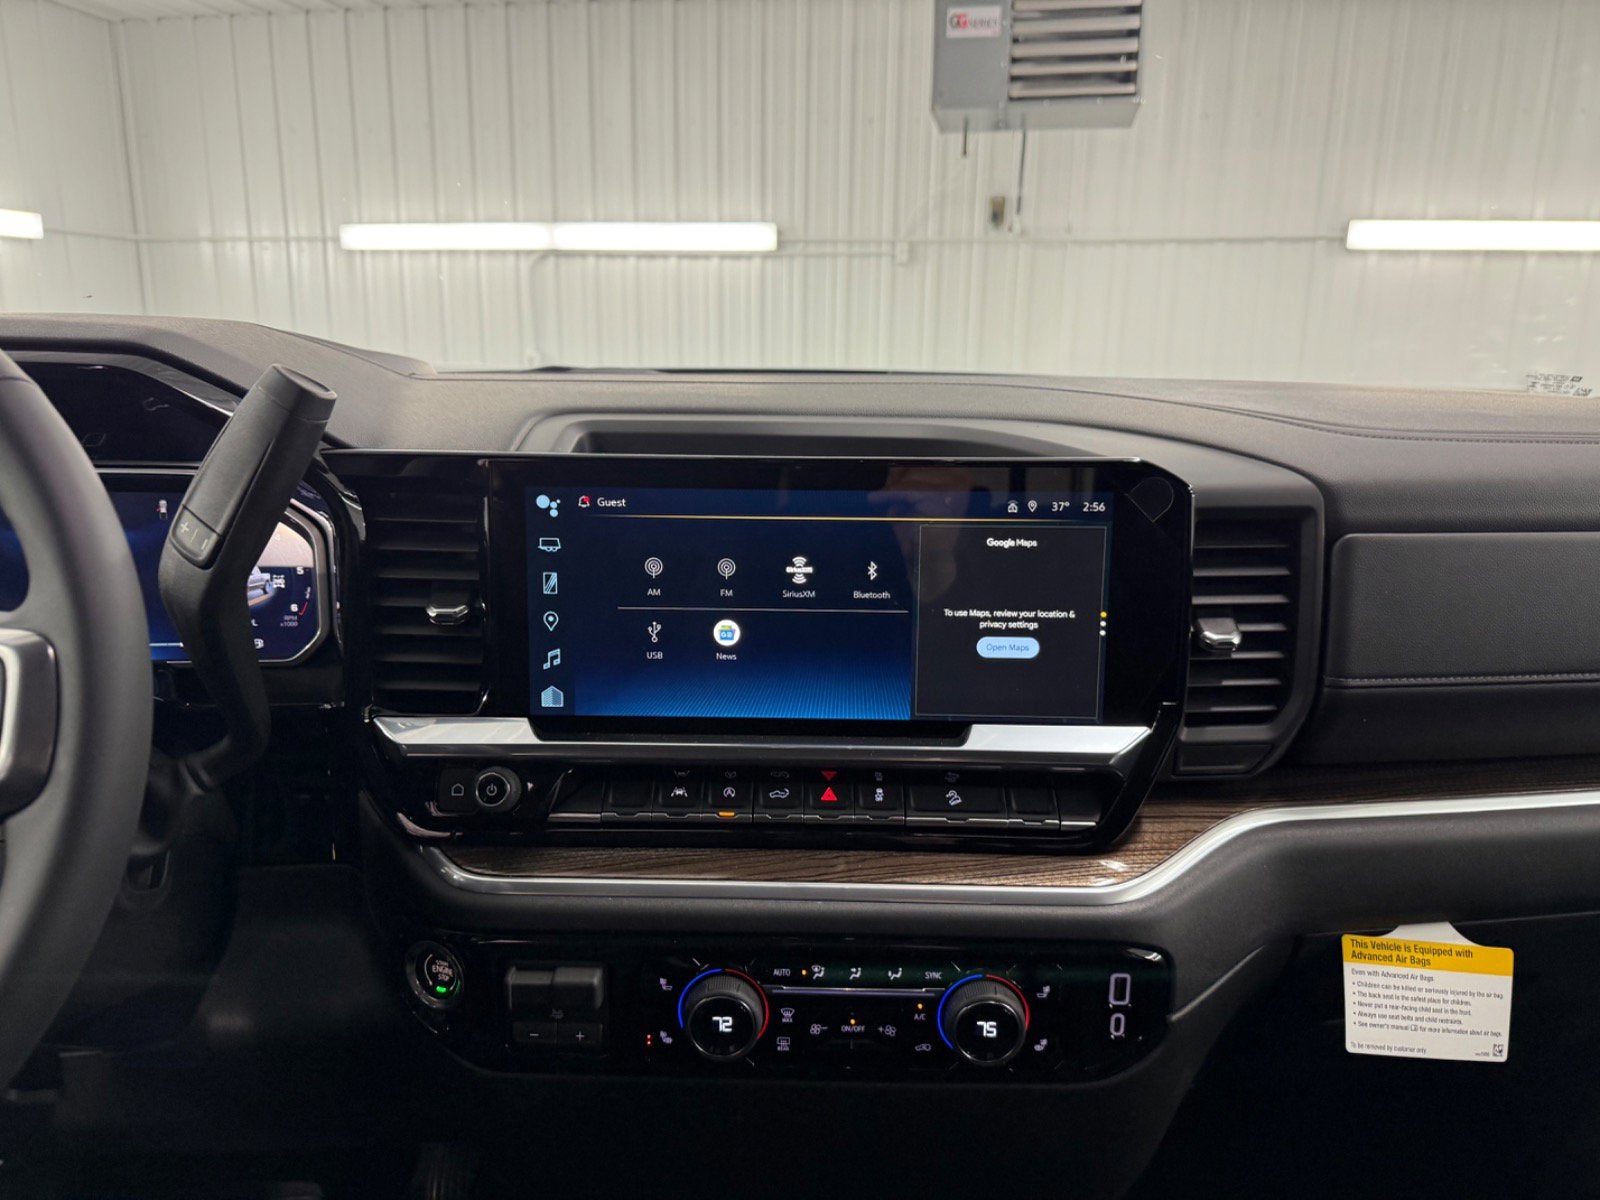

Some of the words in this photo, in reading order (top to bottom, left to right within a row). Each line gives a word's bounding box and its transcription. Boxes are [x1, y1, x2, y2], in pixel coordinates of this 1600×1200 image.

[597, 497, 626, 507] Guest
[1082, 502, 1106, 512] 2:56
[986, 537, 1014, 549] Google
[1016, 538, 1037, 548] Maps
[297, 567, 304, 575] 5
[647, 588, 661, 596] AM
[720, 588, 733, 597] FM
[782, 589, 816, 598] SiriusXM
[853, 590, 891, 599] Bluetooth
[291, 603, 298, 612] 6
[943, 608, 953, 617] To
[954, 609, 968, 617] use
[969, 609, 992, 618] Maps,
[993, 609, 1018, 618] review
[1019, 610, 1036, 619] your
[1037, 609, 1068, 618] location
[1069, 610, 1076, 618] &
[979, 620, 1007, 630] privacy
[1008, 620, 1039, 631] settings
[986, 643, 1007, 653] Open
[1009, 644, 1030, 653] Maps
[646, 651, 663, 660] USB
[716, 652, 737, 660] News
[1351, 939, 1368, 949] This
[1370, 940, 1402, 952] Vehicle
[1414, 944, 1453, 957] Equipped
[1455, 947, 1473, 958] with
[1351, 950, 1393, 962] Advanced
[1396, 953, 1407, 964] Air
[1410, 955, 1431, 967] Bags
[773, 968, 791, 976] AUTO
[924, 971, 943, 980] SYNC
[1367, 969, 1379, 977] with
[1381, 970, 1409, 979] Advanced
[1420, 974, 1434, 983] Bags
[1357, 980, 1379, 988] Children
[1425, 987, 1449, 995] seriously
[1450, 988, 1468, 997] injured
[1469, 990, 1475, 998] by
[1357, 990, 1367, 998] The
[1358, 1000, 1373, 1008] Never
[913, 1013, 926, 1021] A/C
[1358, 1010, 1377, 1019] Always
[712, 1016, 732, 1032] 72
[976, 1020, 997, 1037] 75
